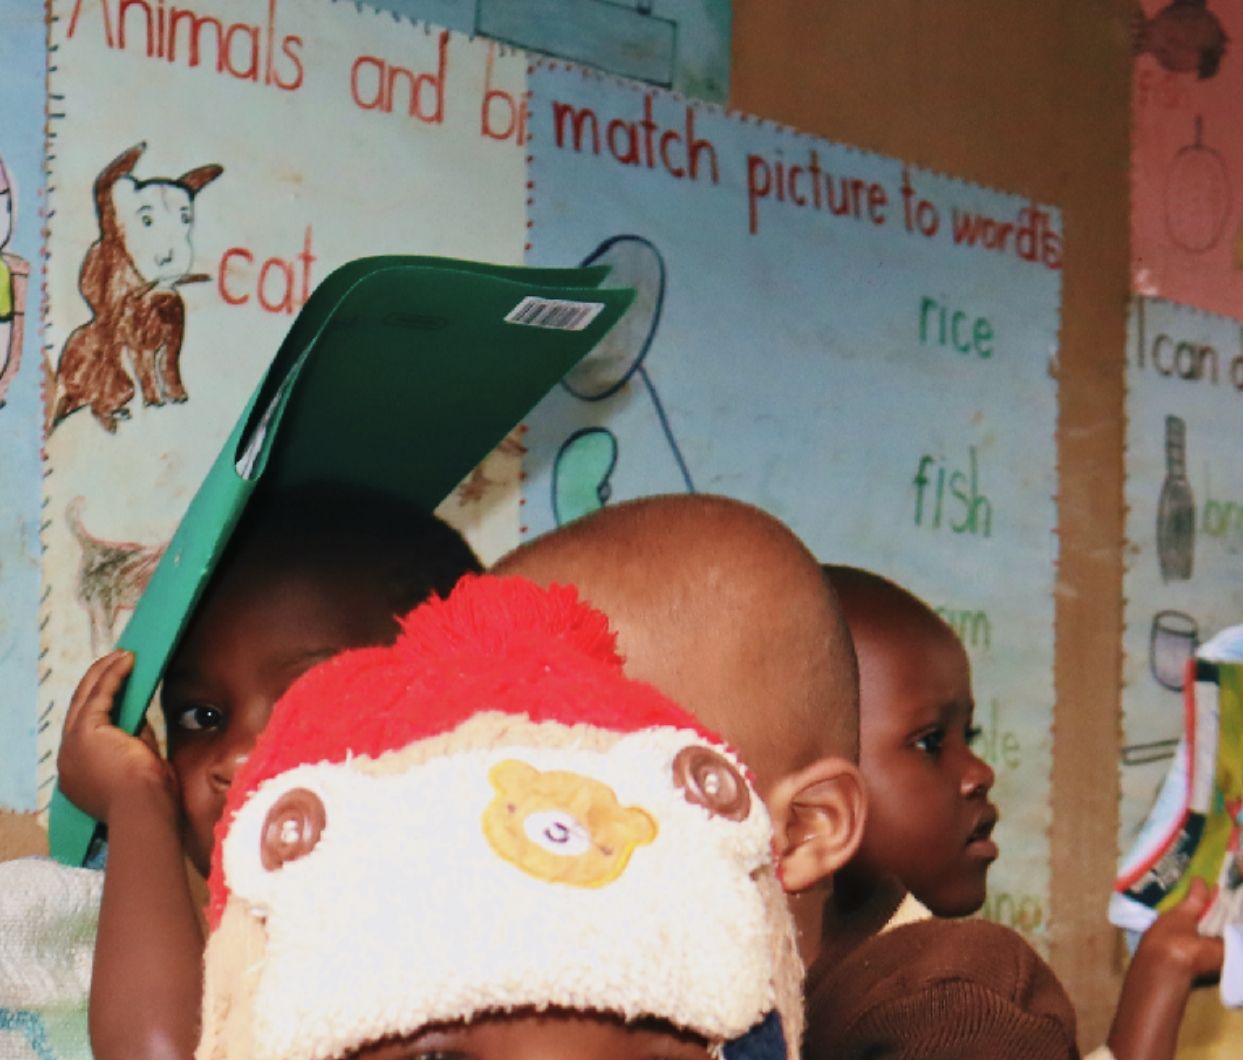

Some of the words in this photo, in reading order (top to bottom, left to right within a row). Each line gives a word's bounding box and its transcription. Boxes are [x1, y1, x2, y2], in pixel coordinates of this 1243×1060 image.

[350, 30, 449, 125] and
[552, 95, 720, 185] match
[747, 148, 888, 235] picture
[899, 166, 941, 237] to
[218, 222, 318, 315] cat
[917, 296, 993, 359] rice
[1152, 333, 1220, 384] can
[912, 445, 993, 538] fish
